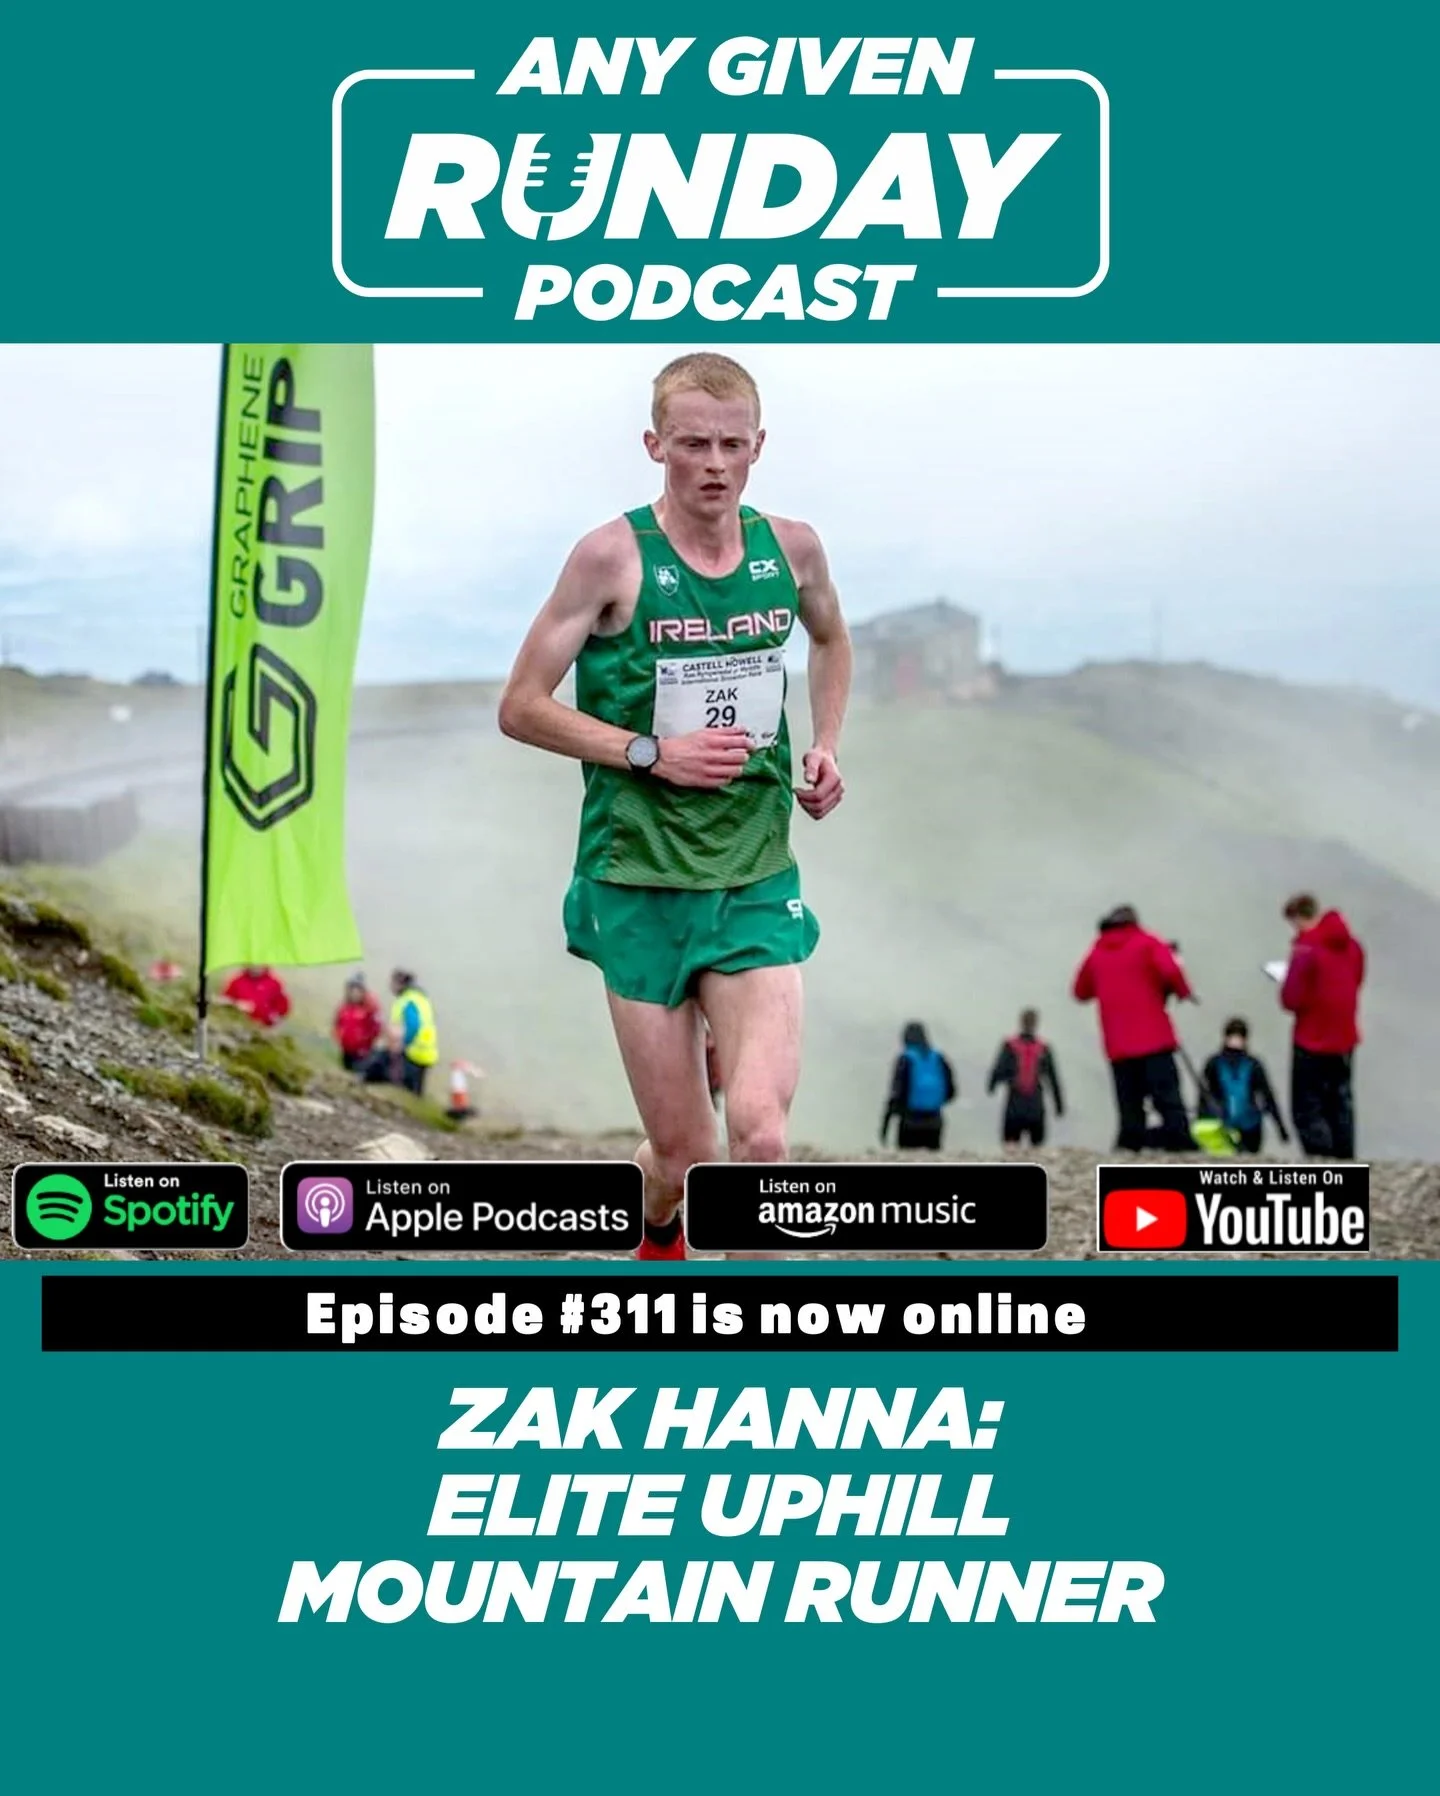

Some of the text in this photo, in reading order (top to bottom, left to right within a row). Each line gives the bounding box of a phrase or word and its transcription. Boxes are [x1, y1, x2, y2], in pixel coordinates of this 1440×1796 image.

[230, 354, 264, 620] GRAPHENE
[253, 357, 325, 629] GRIP
[748, 559, 779, 574] CX
[649, 608, 792, 643] IRELAND
[682, 660, 723, 673] CASTELL
[725, 656, 762, 668] HOWELL
[705, 687, 739, 703] ZAK
[705, 705, 736, 729] 29
